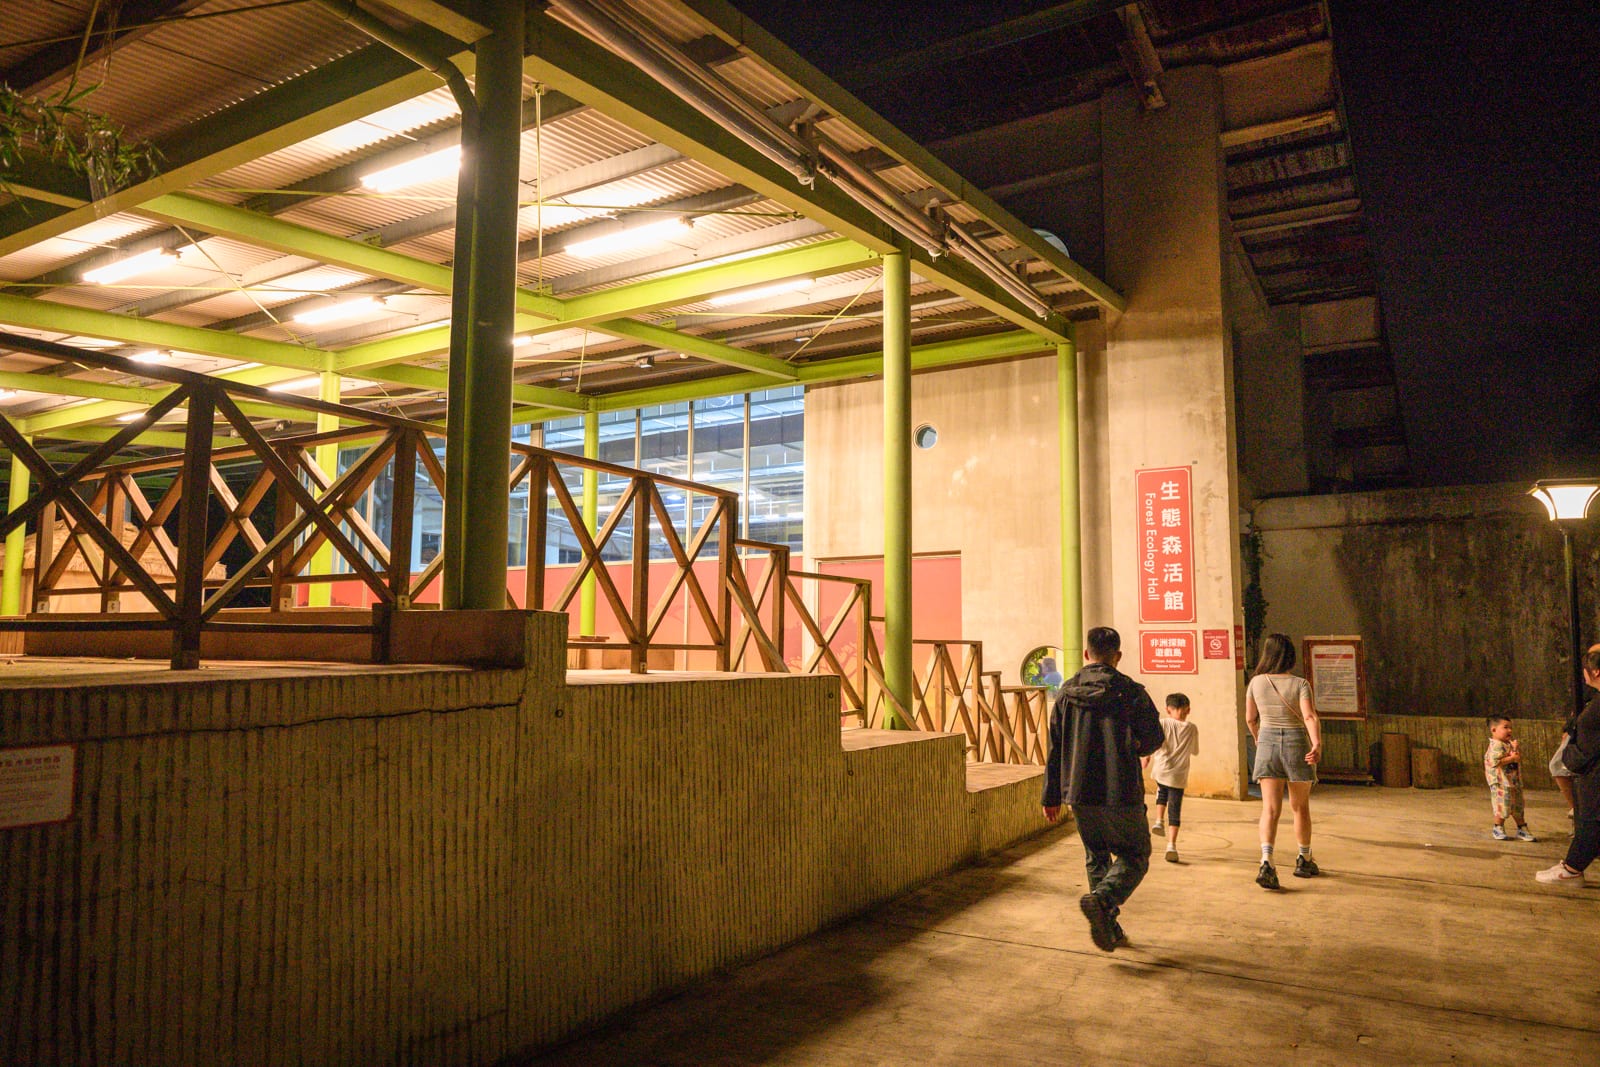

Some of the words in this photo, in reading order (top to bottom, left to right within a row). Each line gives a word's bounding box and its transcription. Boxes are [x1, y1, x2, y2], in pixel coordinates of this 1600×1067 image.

[1145, 492, 1156, 526] Forest
[1144, 529, 1158, 574] Ecology
[1160, 480, 1184, 611] 生態森活館
[1147, 577, 1160, 600] Hall
